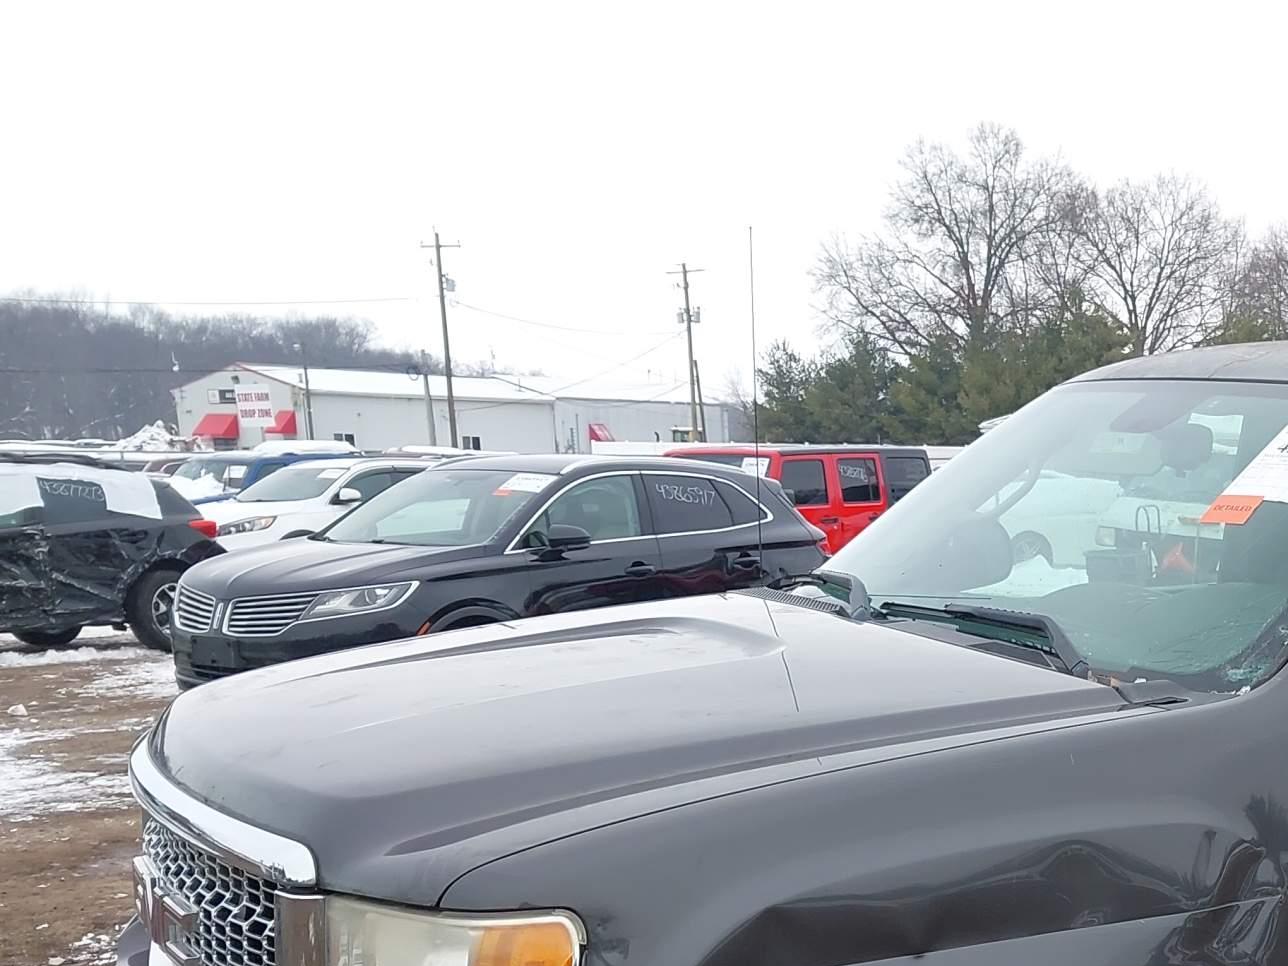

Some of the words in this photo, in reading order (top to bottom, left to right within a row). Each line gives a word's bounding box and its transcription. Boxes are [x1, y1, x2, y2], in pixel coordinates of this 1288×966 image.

[237, 393, 254, 402] STATE
[254, 392, 269, 401] FARM
[240, 409, 256, 418] DROP
[258, 409, 272, 417] ZONE
